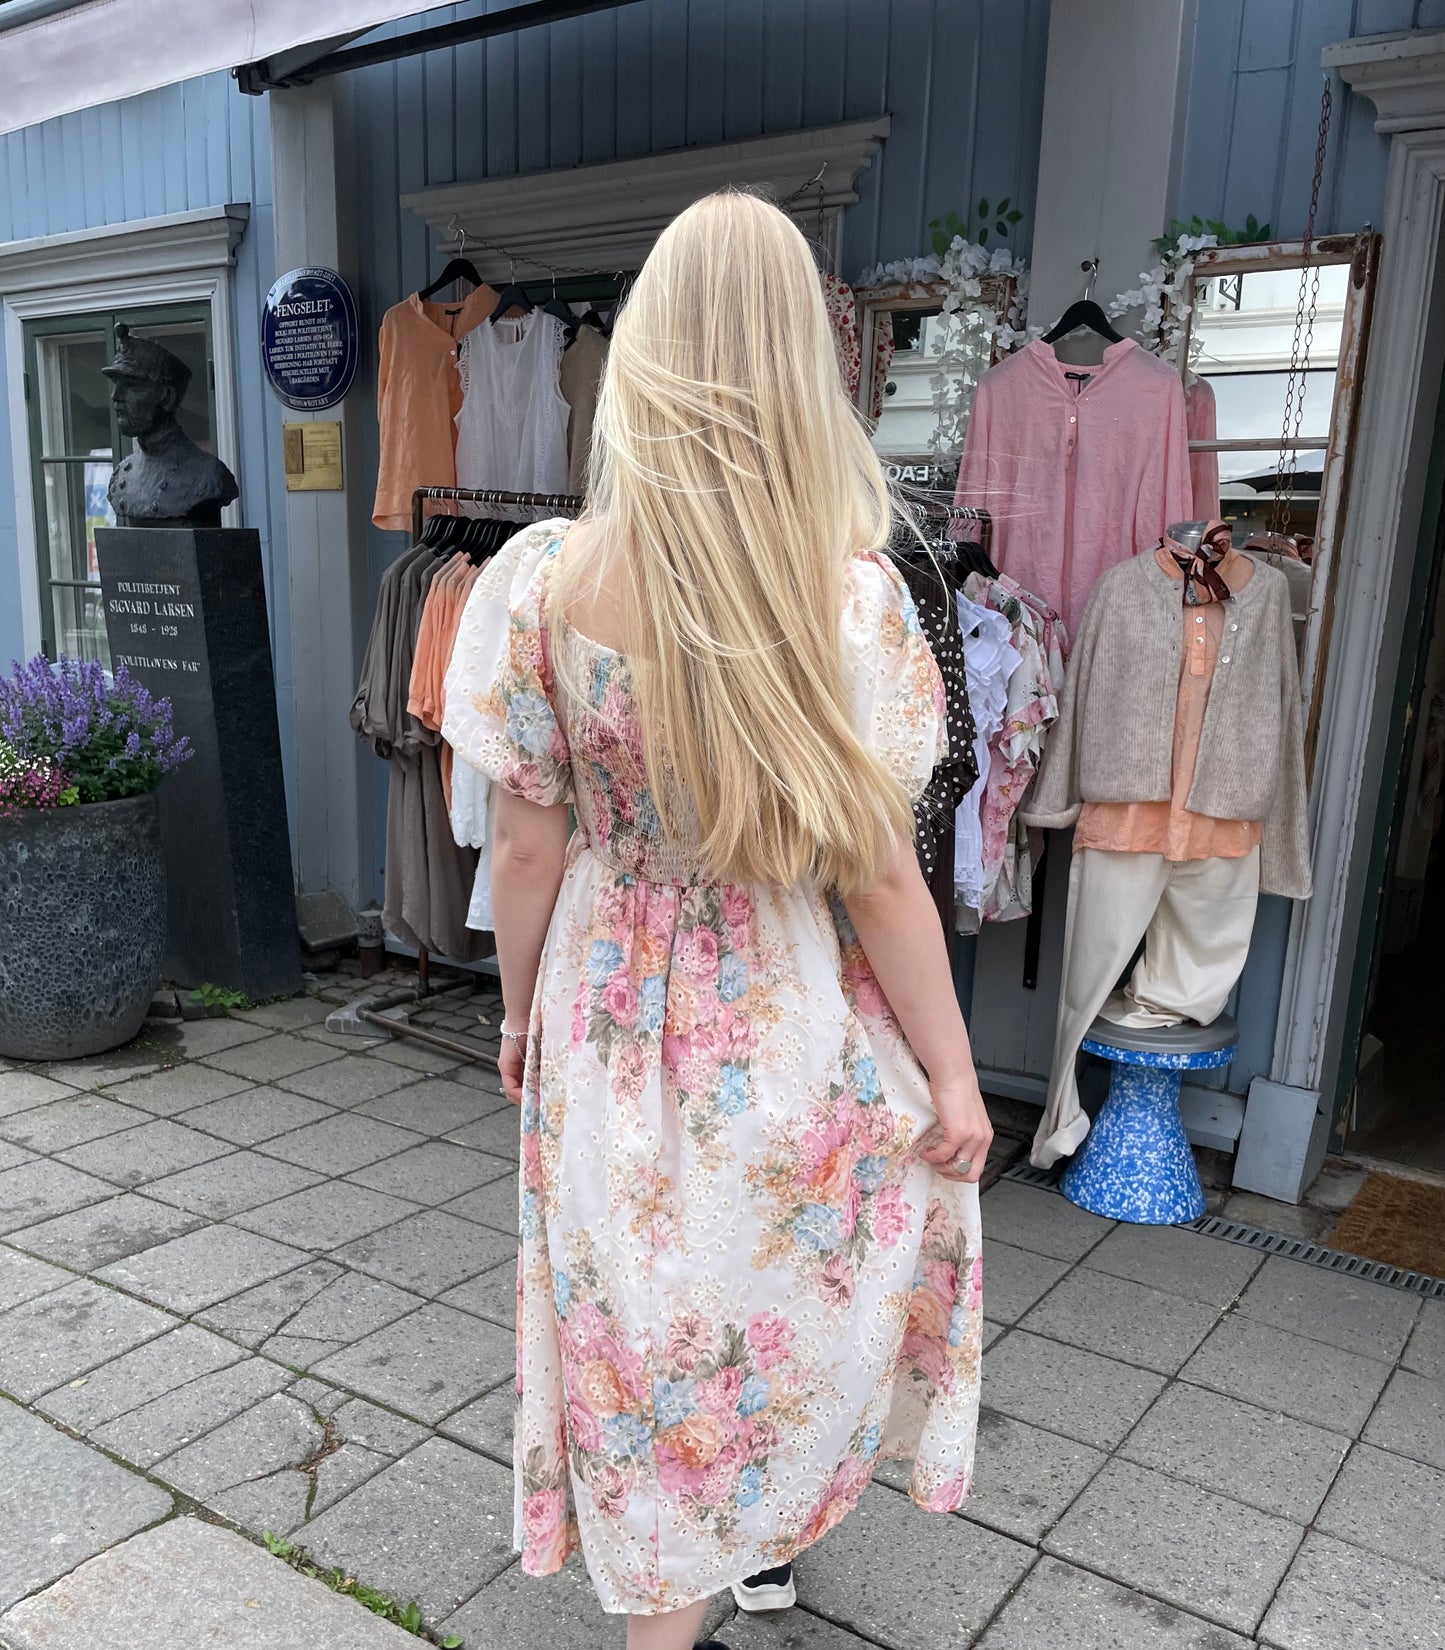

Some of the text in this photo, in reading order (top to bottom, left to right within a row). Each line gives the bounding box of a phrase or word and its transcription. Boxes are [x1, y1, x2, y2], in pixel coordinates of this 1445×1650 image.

[276, 299, 331, 317] FENGSELET
[117, 582, 180, 595] POLITIBETJENT
[109, 599, 195, 618] SIGVARD LARSEN
[161, 625, 178, 636] 1928
